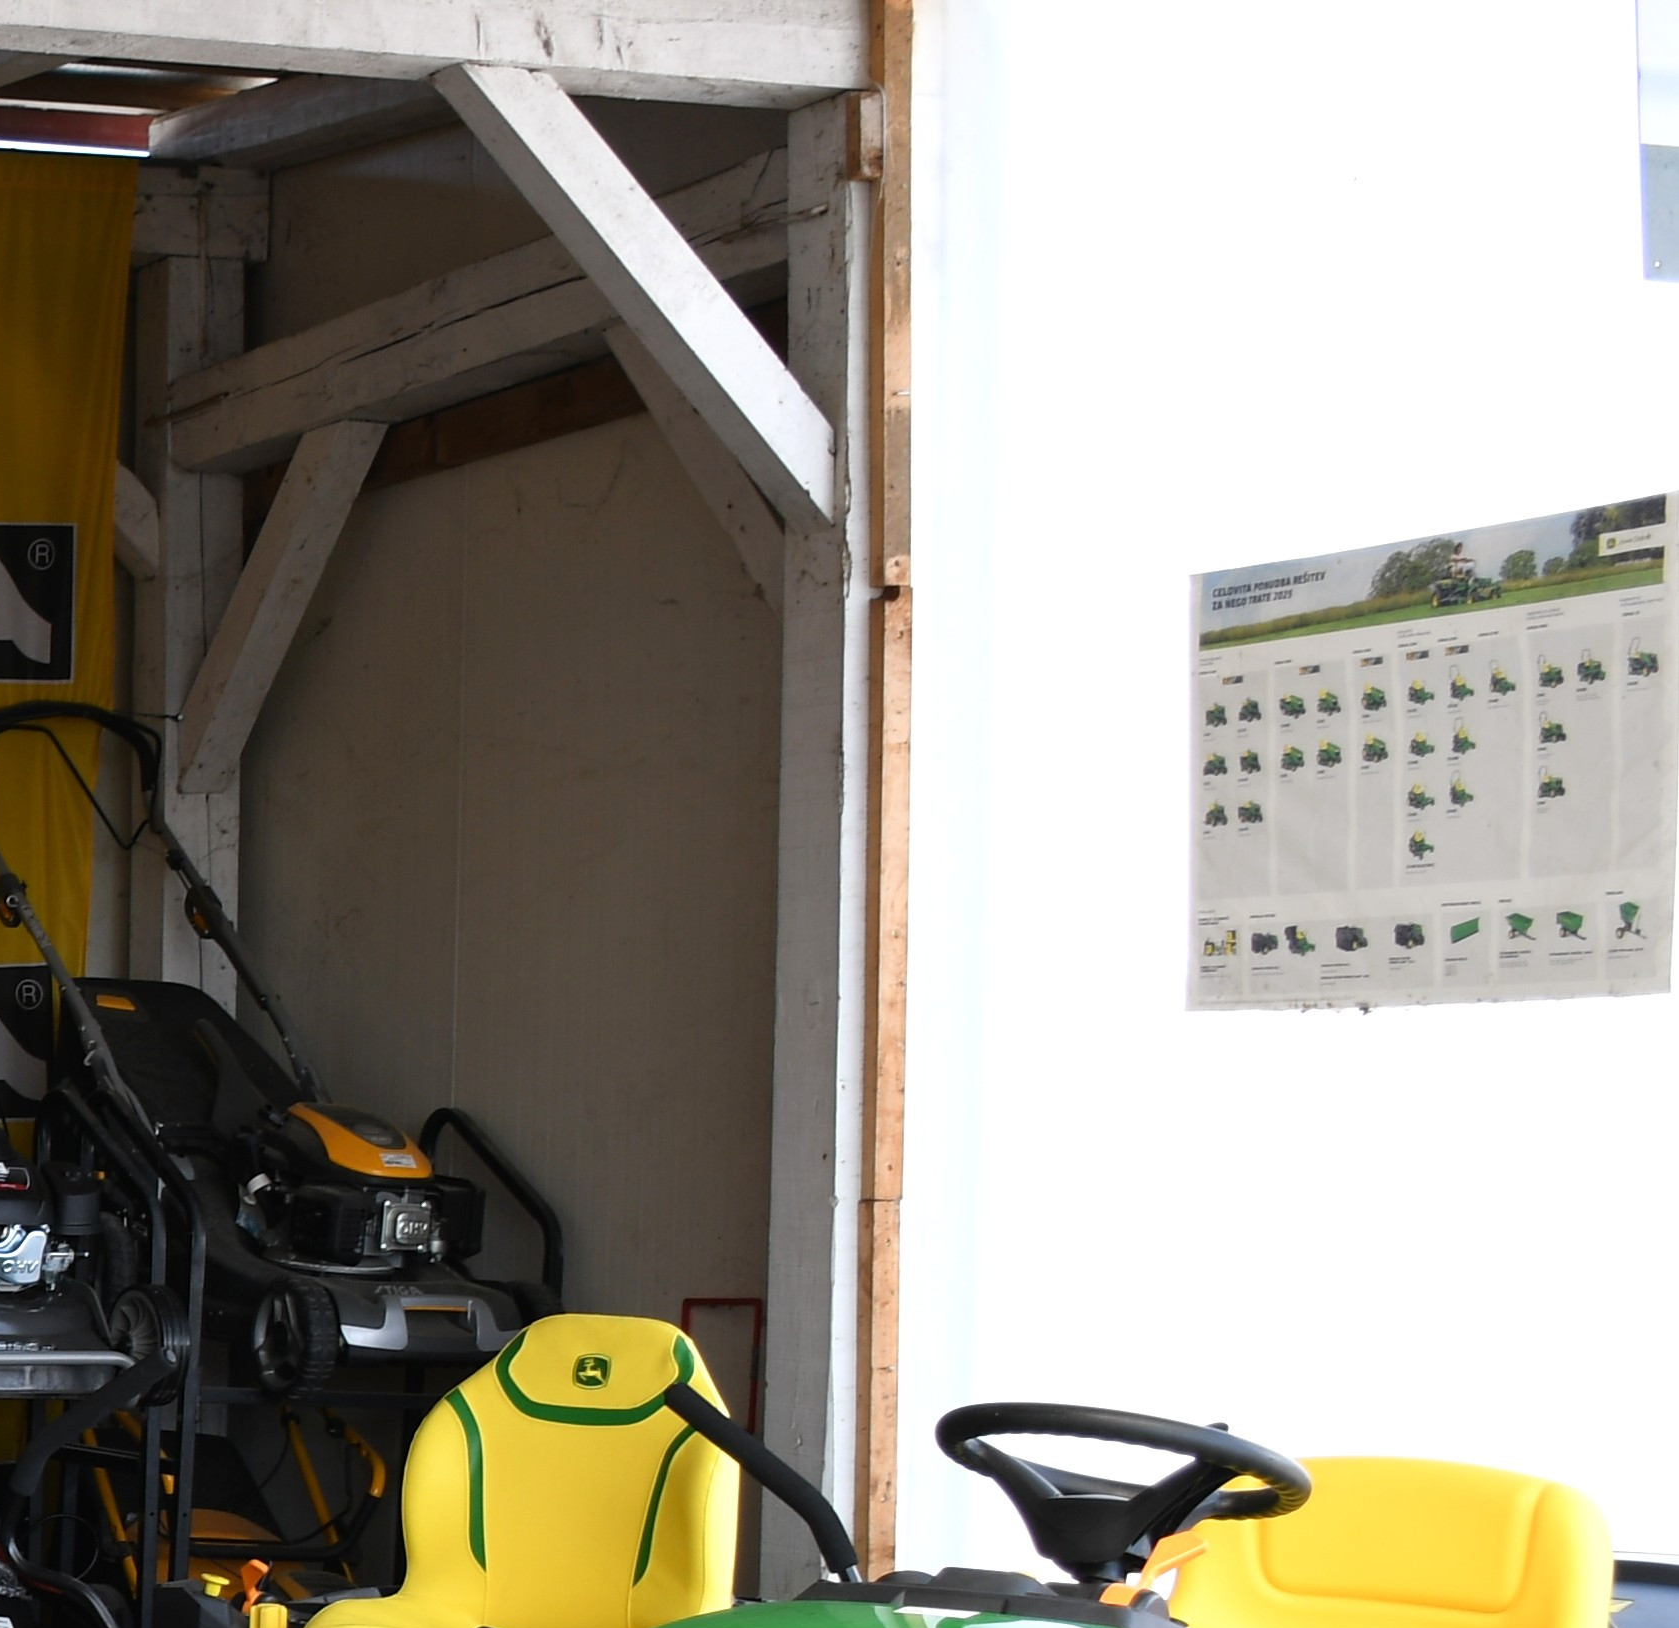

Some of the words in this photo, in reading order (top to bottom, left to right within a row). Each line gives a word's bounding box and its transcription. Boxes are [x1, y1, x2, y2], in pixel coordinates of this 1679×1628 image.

[1212, 583, 1252, 598] CELOVITA
[1253, 577, 1291, 591] PONUDBA
[1293, 570, 1327, 585] REŠITEV
[1212, 600, 1223, 611] ZA
[1225, 597, 1247, 609] NEGO
[1248, 592, 1272, 605] TRATE
[1273, 588, 1294, 601] 2025
